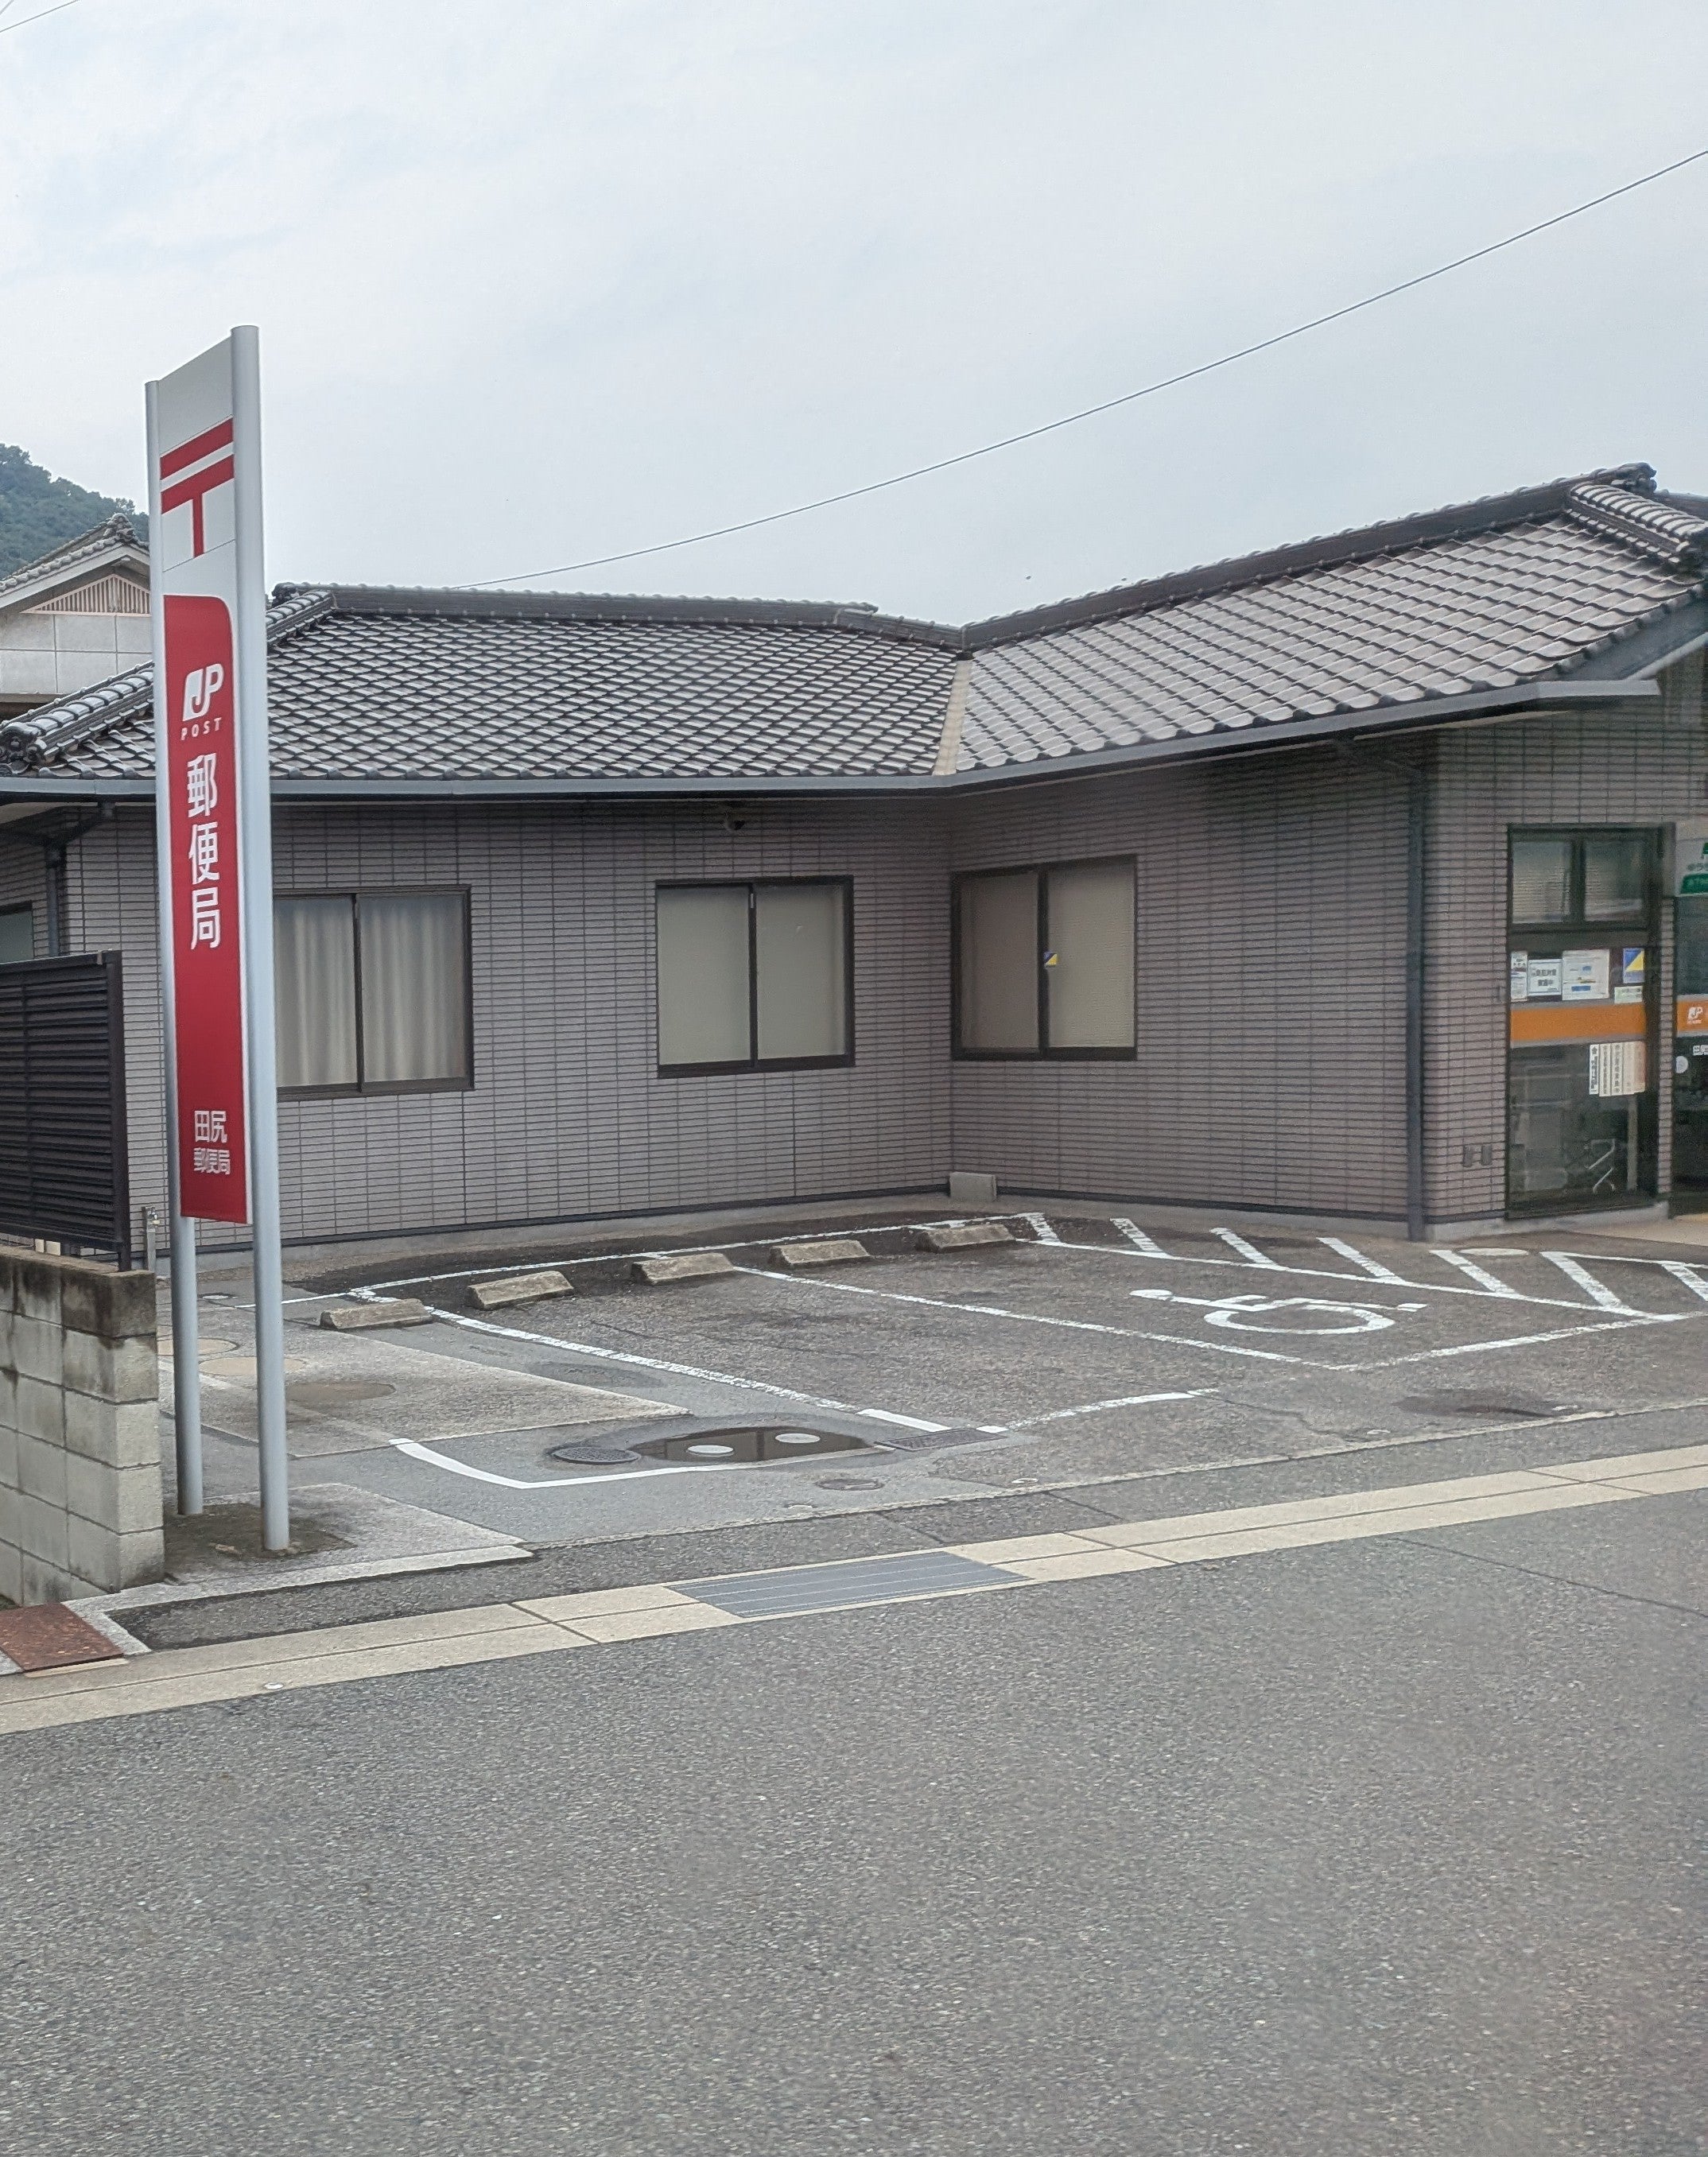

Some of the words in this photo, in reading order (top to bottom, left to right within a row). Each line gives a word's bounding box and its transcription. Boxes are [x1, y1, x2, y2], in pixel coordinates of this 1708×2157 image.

[181, 717, 223, 741] POST
[187, 752, 221, 950] 郵便局
[194, 1110, 227, 1143] 田尻
[193, 1147, 231, 1175] 郵便局
